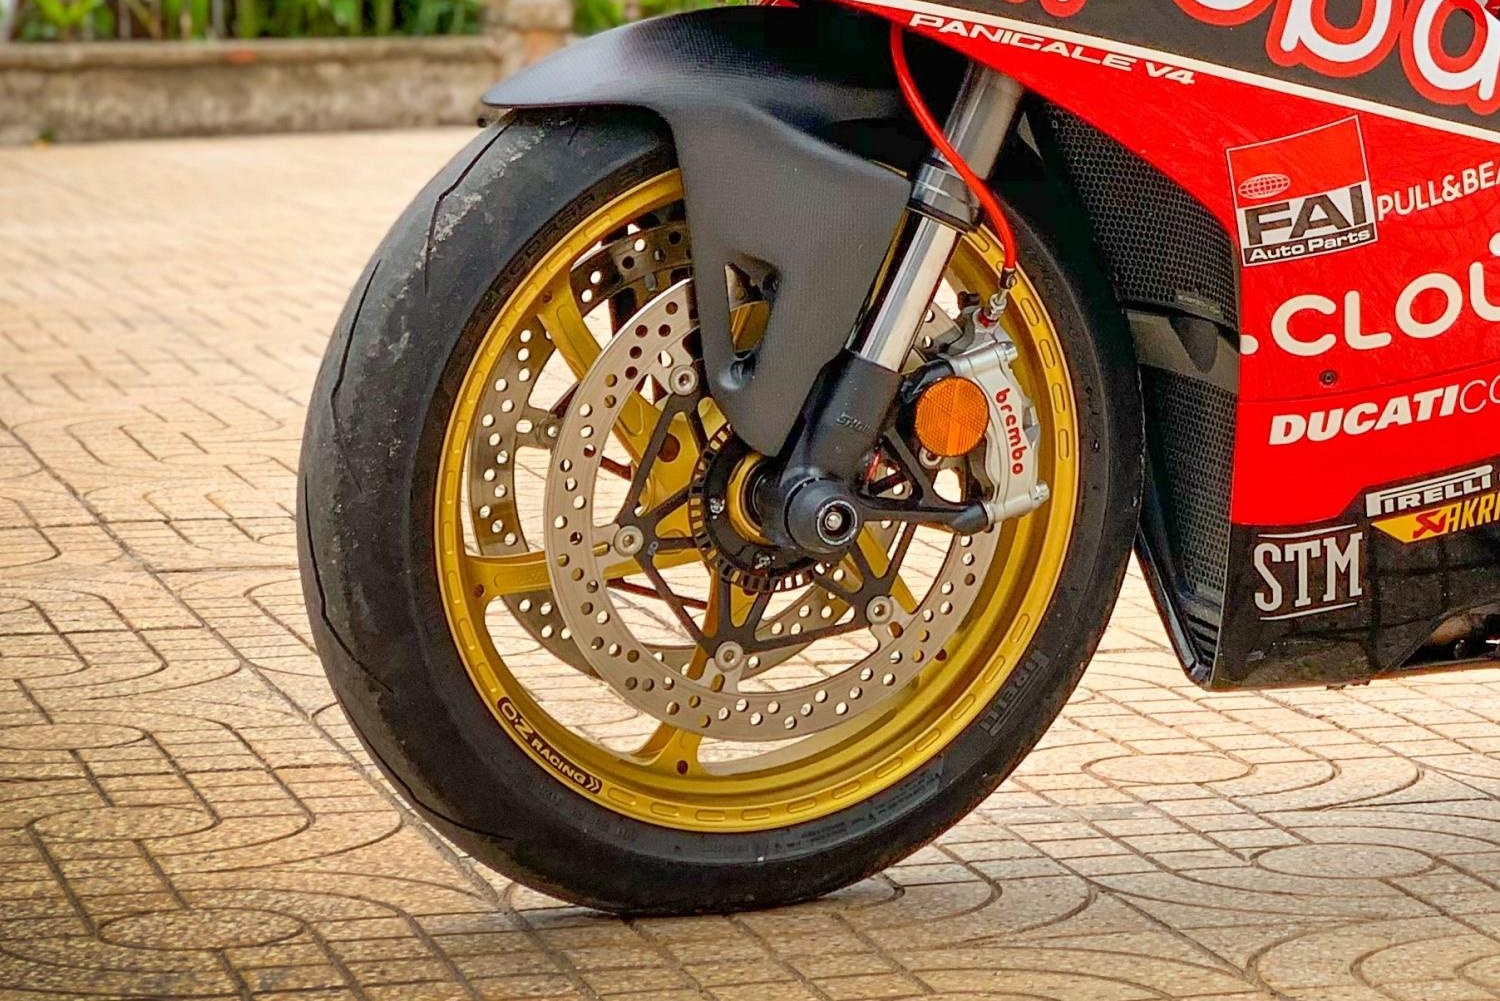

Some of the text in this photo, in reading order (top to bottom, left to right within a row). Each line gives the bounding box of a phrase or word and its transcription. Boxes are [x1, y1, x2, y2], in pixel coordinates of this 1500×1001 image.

[909, 13, 1196, 85] PANIGALE V4
[1244, 184, 1368, 246] FAI
[1249, 229, 1372, 263] Auto Parts
[995, 387, 1028, 475] brembo
[1366, 464, 1493, 518] PIRELLI
[1253, 531, 1364, 612] STM
[530, 738, 587, 786] RACING
